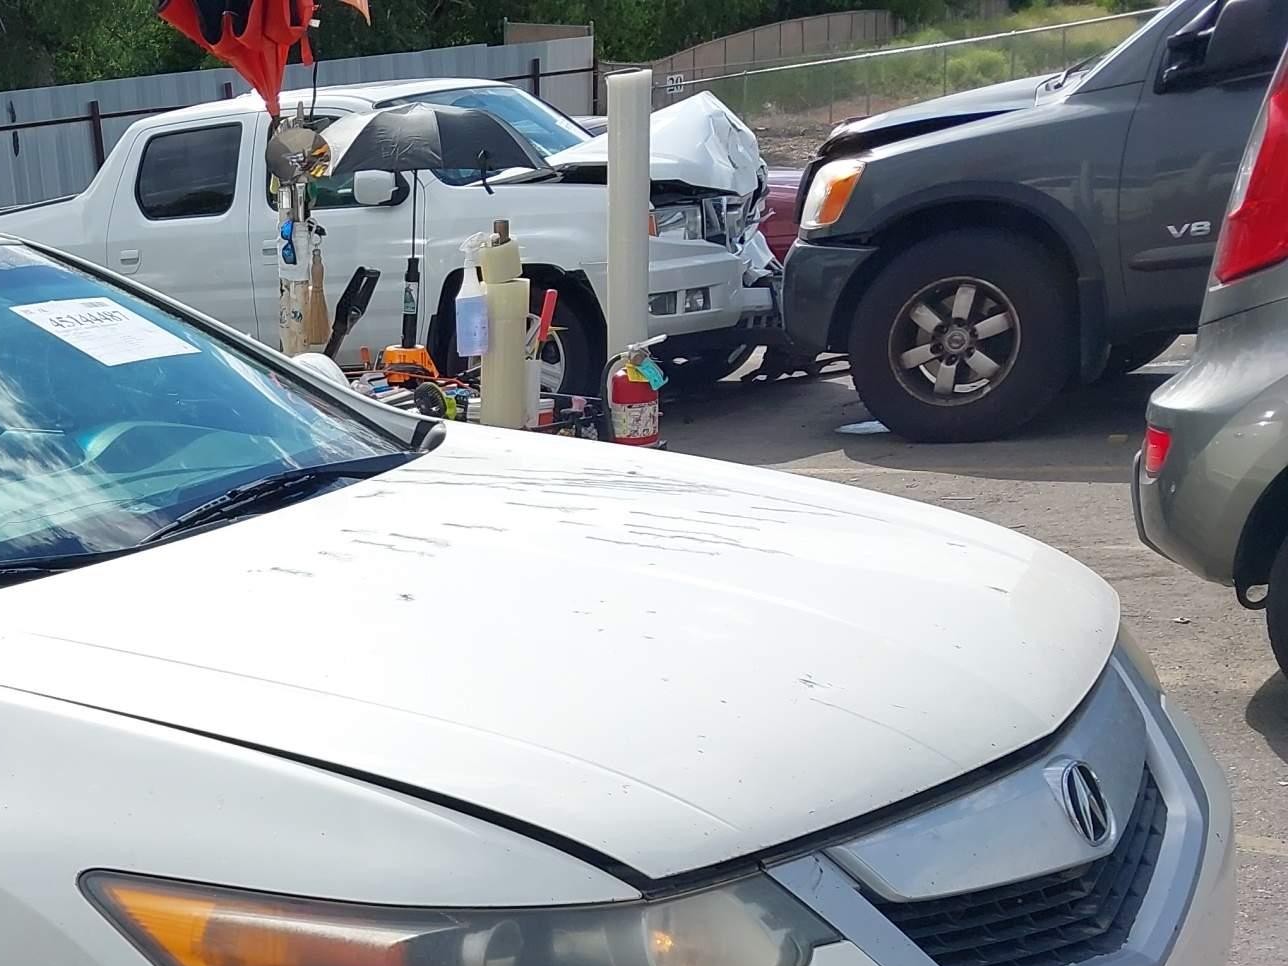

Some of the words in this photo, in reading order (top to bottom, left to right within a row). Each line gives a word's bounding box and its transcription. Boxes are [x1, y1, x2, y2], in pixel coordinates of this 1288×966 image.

[668, 76, 683, 92] 20
[1167, 221, 1211, 238] V8
[48, 310, 130, 328] 45144487
